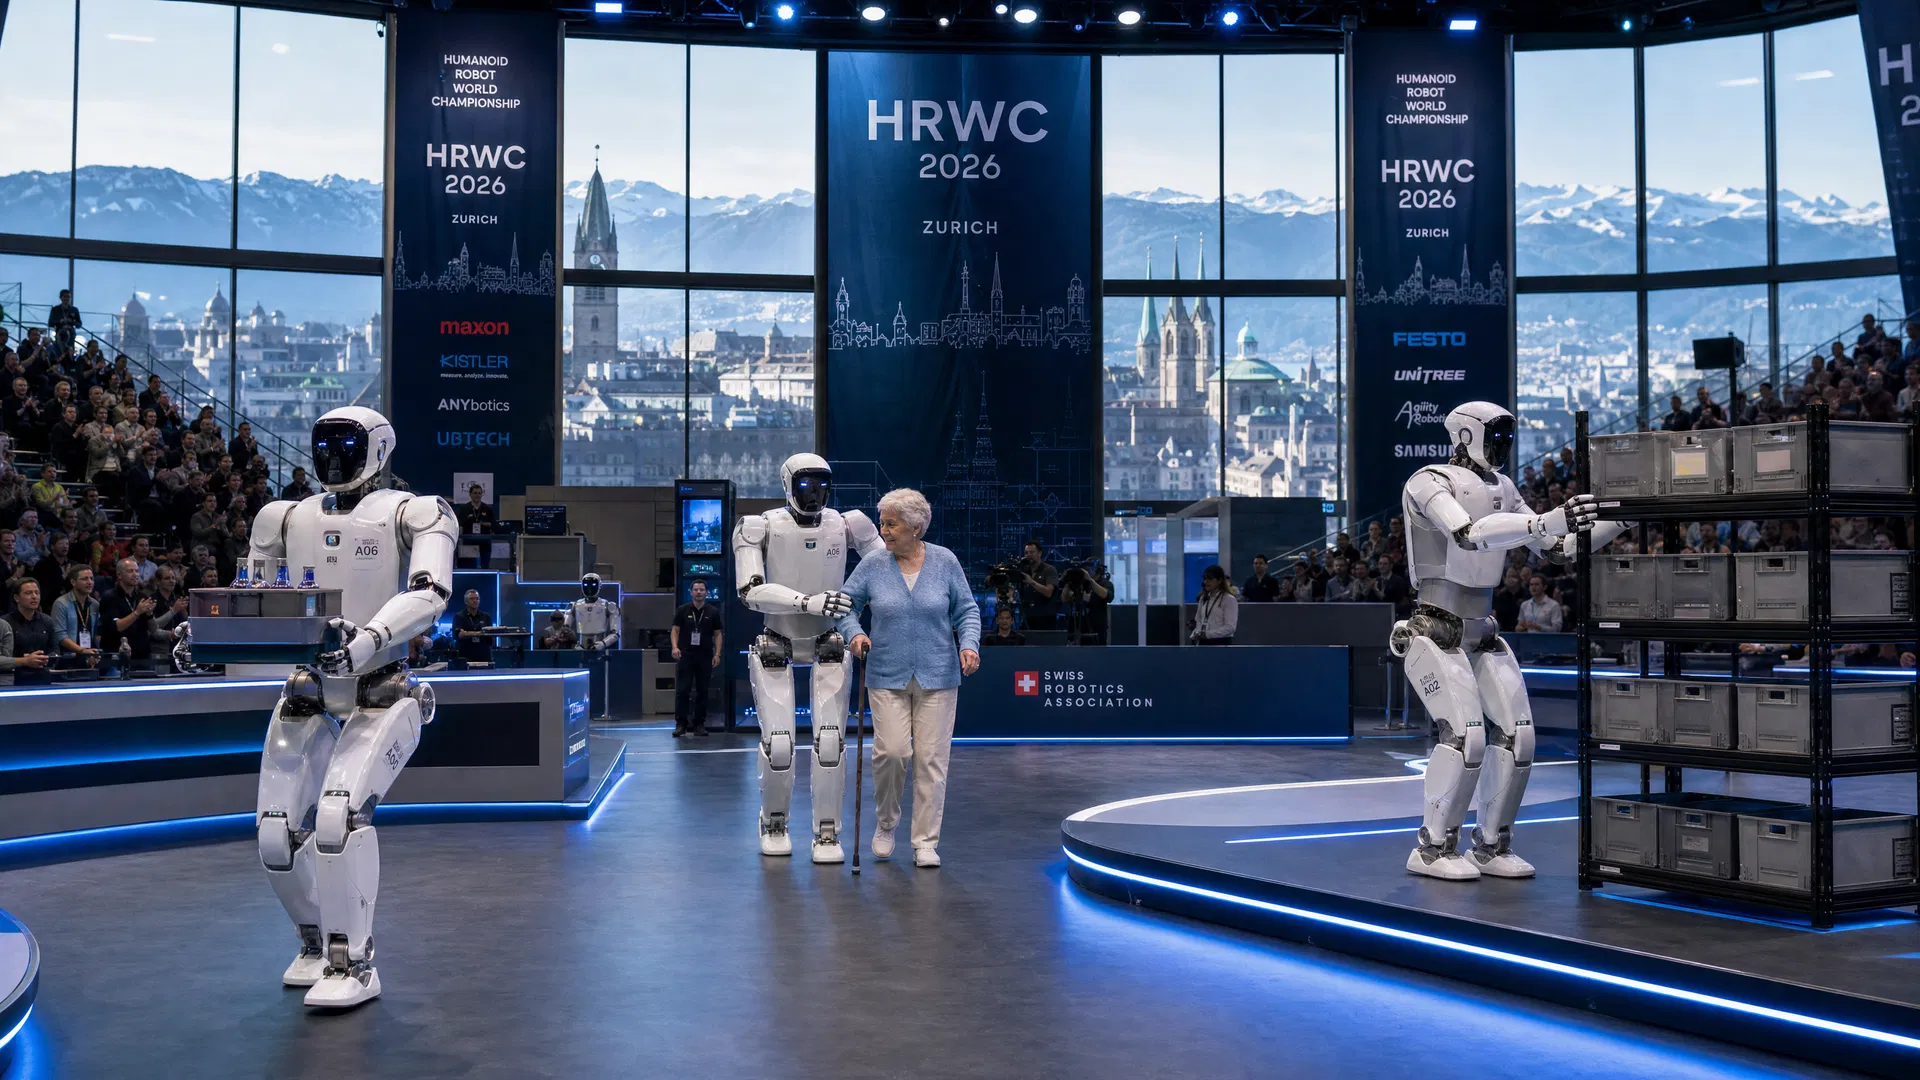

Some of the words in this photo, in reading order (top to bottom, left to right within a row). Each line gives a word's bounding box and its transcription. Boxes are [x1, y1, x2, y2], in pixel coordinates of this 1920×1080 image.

[444, 54, 508, 66] HUMANOID
[455, 69, 496, 80] ROBOT
[1396, 74, 1456, 84] HUMANOID
[453, 83, 497, 94] WORLD
[1407, 87, 1445, 97] ROBOT
[431, 96, 520, 109] CHAMPIONSHIP
[1406, 101, 1446, 111] WORLD
[868, 99, 1048, 143] HRWC
[1386, 114, 1468, 124] CHAMPIONSHIP
[426, 143, 526, 170] HRWC
[919, 153, 1001, 179] 2026
[1381, 159, 1475, 183] HRWC
[445, 174, 506, 195] 2026
[1399, 189, 1456, 209] 2026
[452, 214, 498, 224] ZURICH
[922, 220, 998, 235] ZURICH
[1406, 228, 1449, 238] ZURICH
[440, 320, 510, 335] maxon
[1393, 332, 1466, 346] FESTO
[440, 354, 508, 368] KISTLER
[437, 398, 510, 412] ANYbotics
[1411, 413, 1446, 426] Roboti
[437, 431, 510, 447] UBTECH
[355, 545, 379, 556] A06
[1044, 671, 1084, 680] SWISS
[1044, 684, 1124, 694] ROBOTICS
[1424, 680, 1440, 697] A02
[1044, 698, 1153, 707] ASSOCIATION
